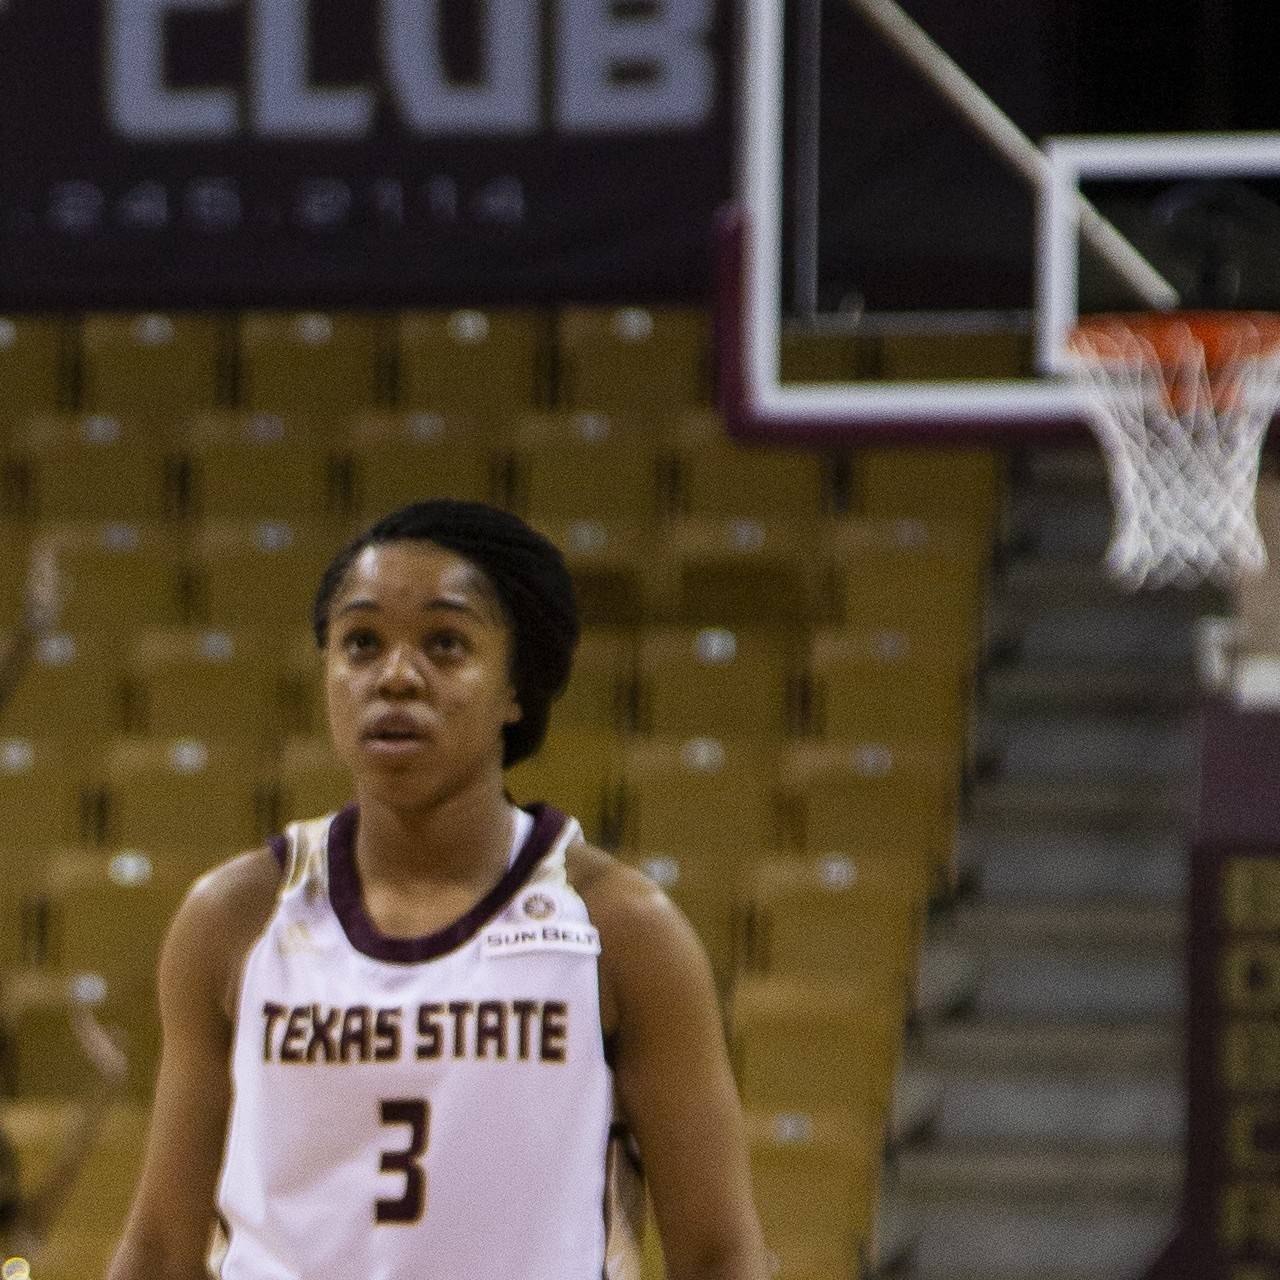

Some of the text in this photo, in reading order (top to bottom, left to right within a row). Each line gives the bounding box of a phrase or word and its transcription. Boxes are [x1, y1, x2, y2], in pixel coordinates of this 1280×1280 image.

[261, 999, 569, 1066] TEXAS STATE
[374, 1097, 430, 1227] 3
